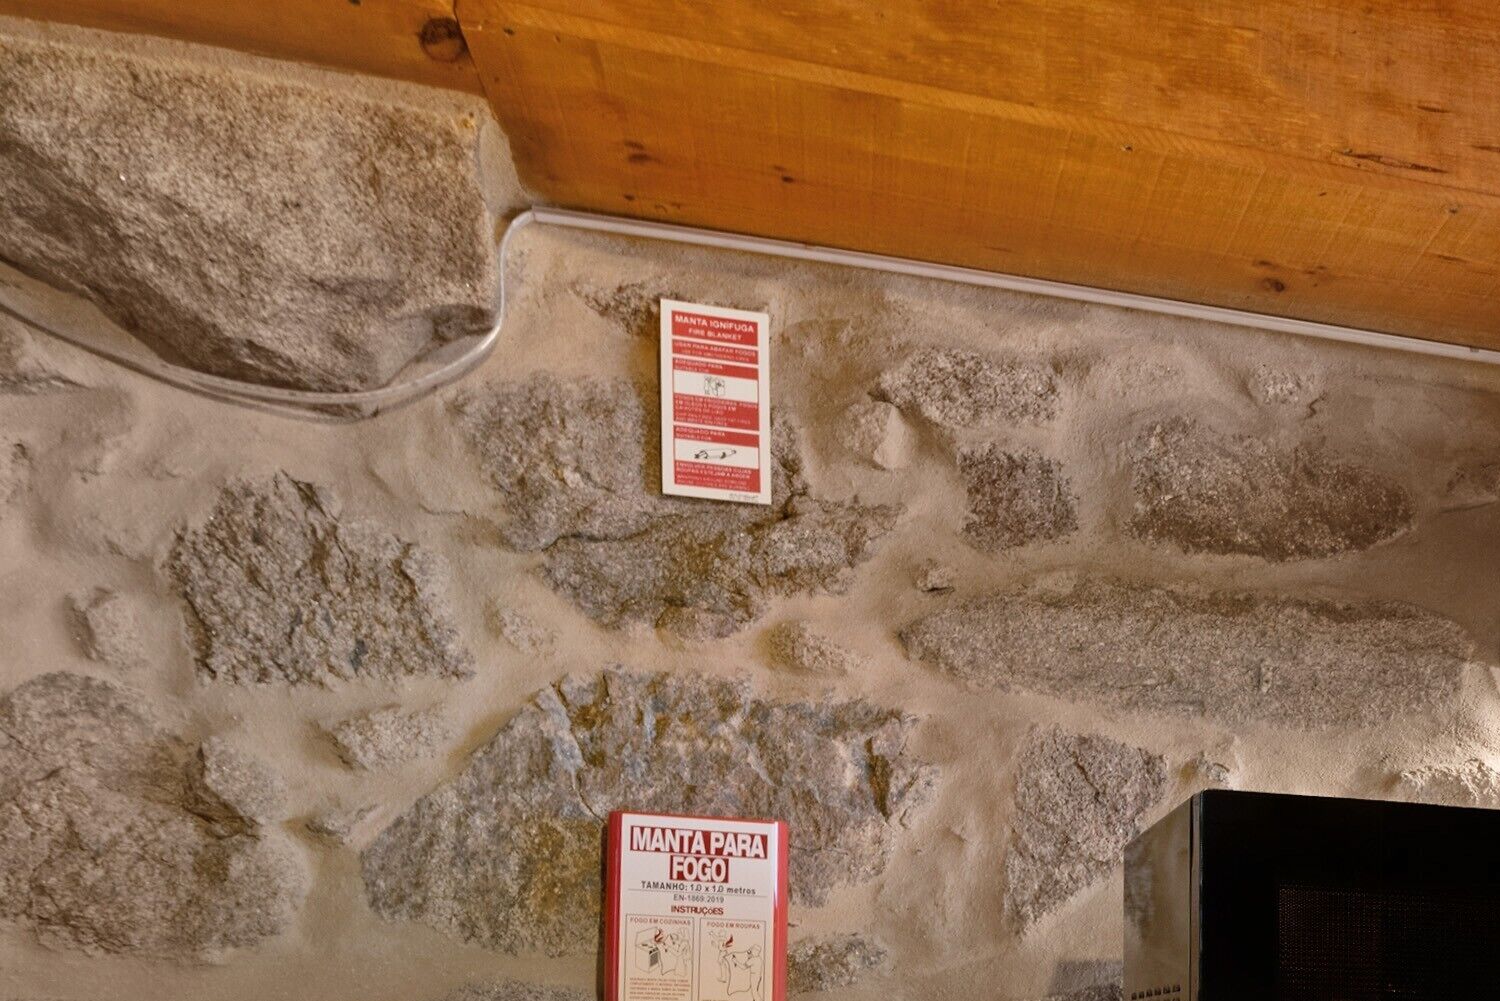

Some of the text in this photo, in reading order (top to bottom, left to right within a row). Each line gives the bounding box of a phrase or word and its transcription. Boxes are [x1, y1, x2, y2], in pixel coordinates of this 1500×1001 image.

[674, 314, 708, 327] MANTA
[688, 327, 742, 341] FIRE BLANKET
[632, 826, 765, 858] MANTA PARA
[672, 856, 726, 882] FOGO
[641, 880, 687, 891] TAMANHO:
[726, 886, 756, 895] metros
[630, 916, 648, 924] FOGO
[659, 918, 691, 926] COZINHAS
